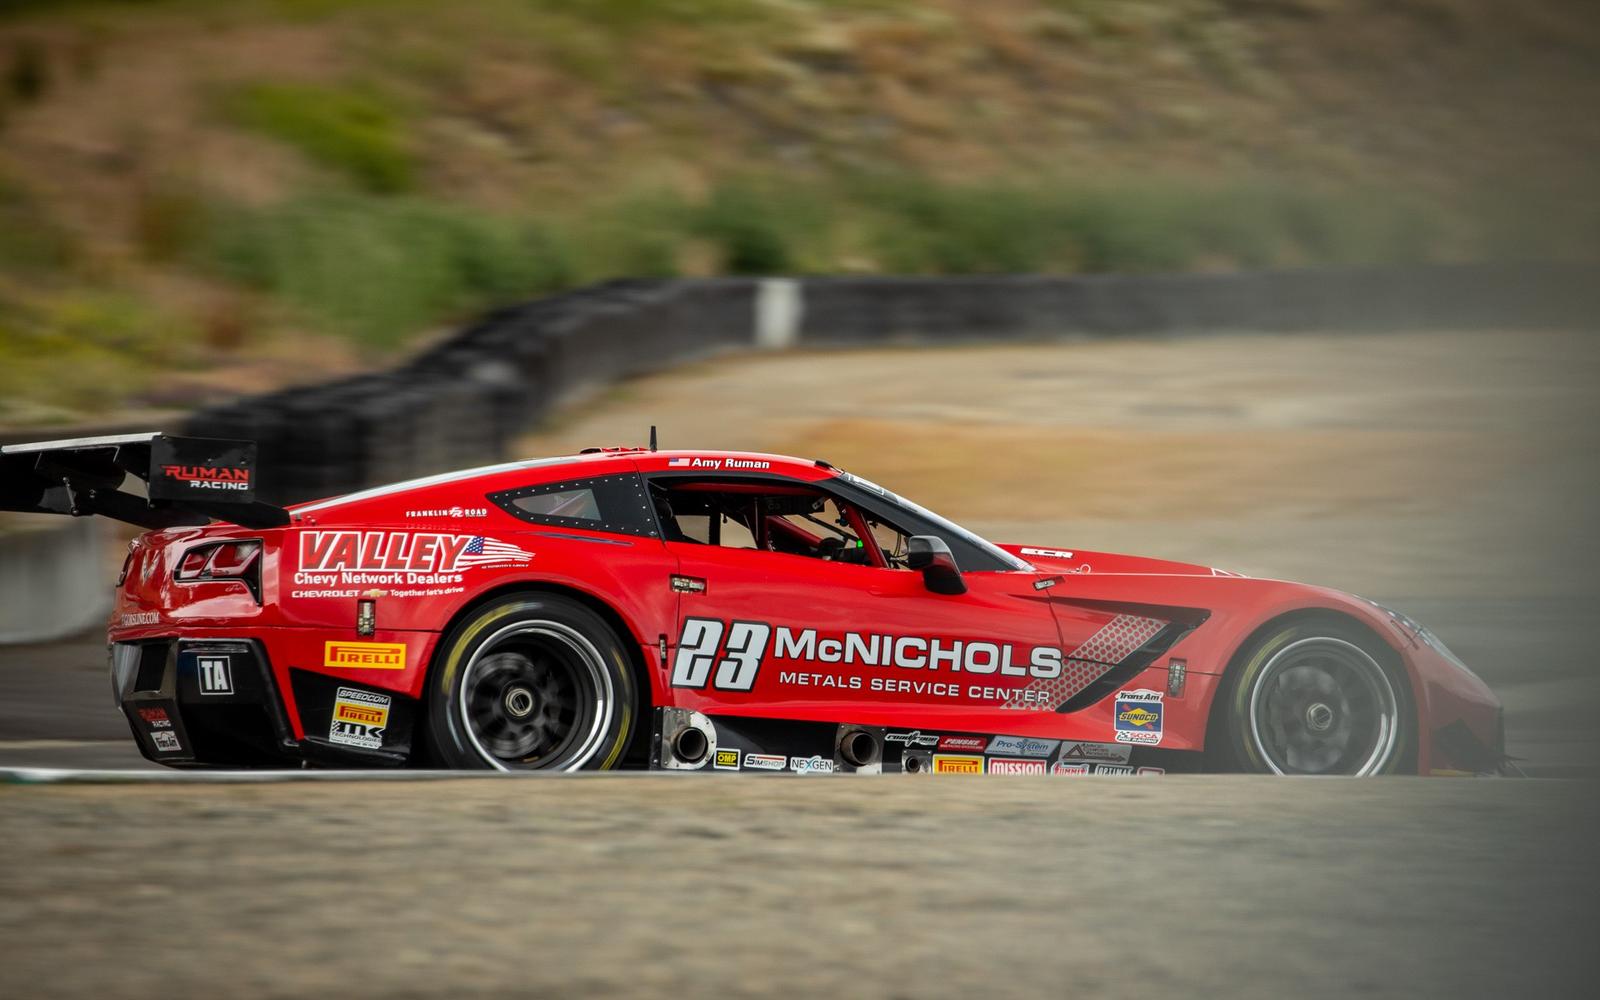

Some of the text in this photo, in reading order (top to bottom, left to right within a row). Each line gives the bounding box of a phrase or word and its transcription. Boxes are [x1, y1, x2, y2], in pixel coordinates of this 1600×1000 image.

[692, 458, 770, 470] Amy Ruman
[161, 465, 248, 482] RUMAN
[190, 480, 248, 490] RACING
[405, 509, 449, 518] FRANKLIN
[465, 508, 487, 517] ROAD
[300, 531, 471, 572] VALLEY
[294, 572, 463, 587] Chevy Network Dealers
[291, 586, 465, 599] CHEVROLET Together let's drive
[330, 646, 401, 664] PIRELLI
[670, 616, 772, 693] 23
[774, 627, 1063, 679] McNICHOLS
[201, 661, 228, 690] TA
[779, 671, 1050, 703] METALS SERVICE CENTER
[339, 690, 388, 704] SPEEDCOM
[1119, 692, 1160, 701] Trans Am
[338, 705, 383, 723] PIRELLI
[1120, 712, 1157, 722] SUNOCO
[945, 738, 981, 747] PENSKE
[997, 740, 1049, 751] Pro-System
[718, 754, 737, 763] OMP
[791, 757, 832, 771] NEXGEN
[939, 760, 978, 773] PIRELLI
